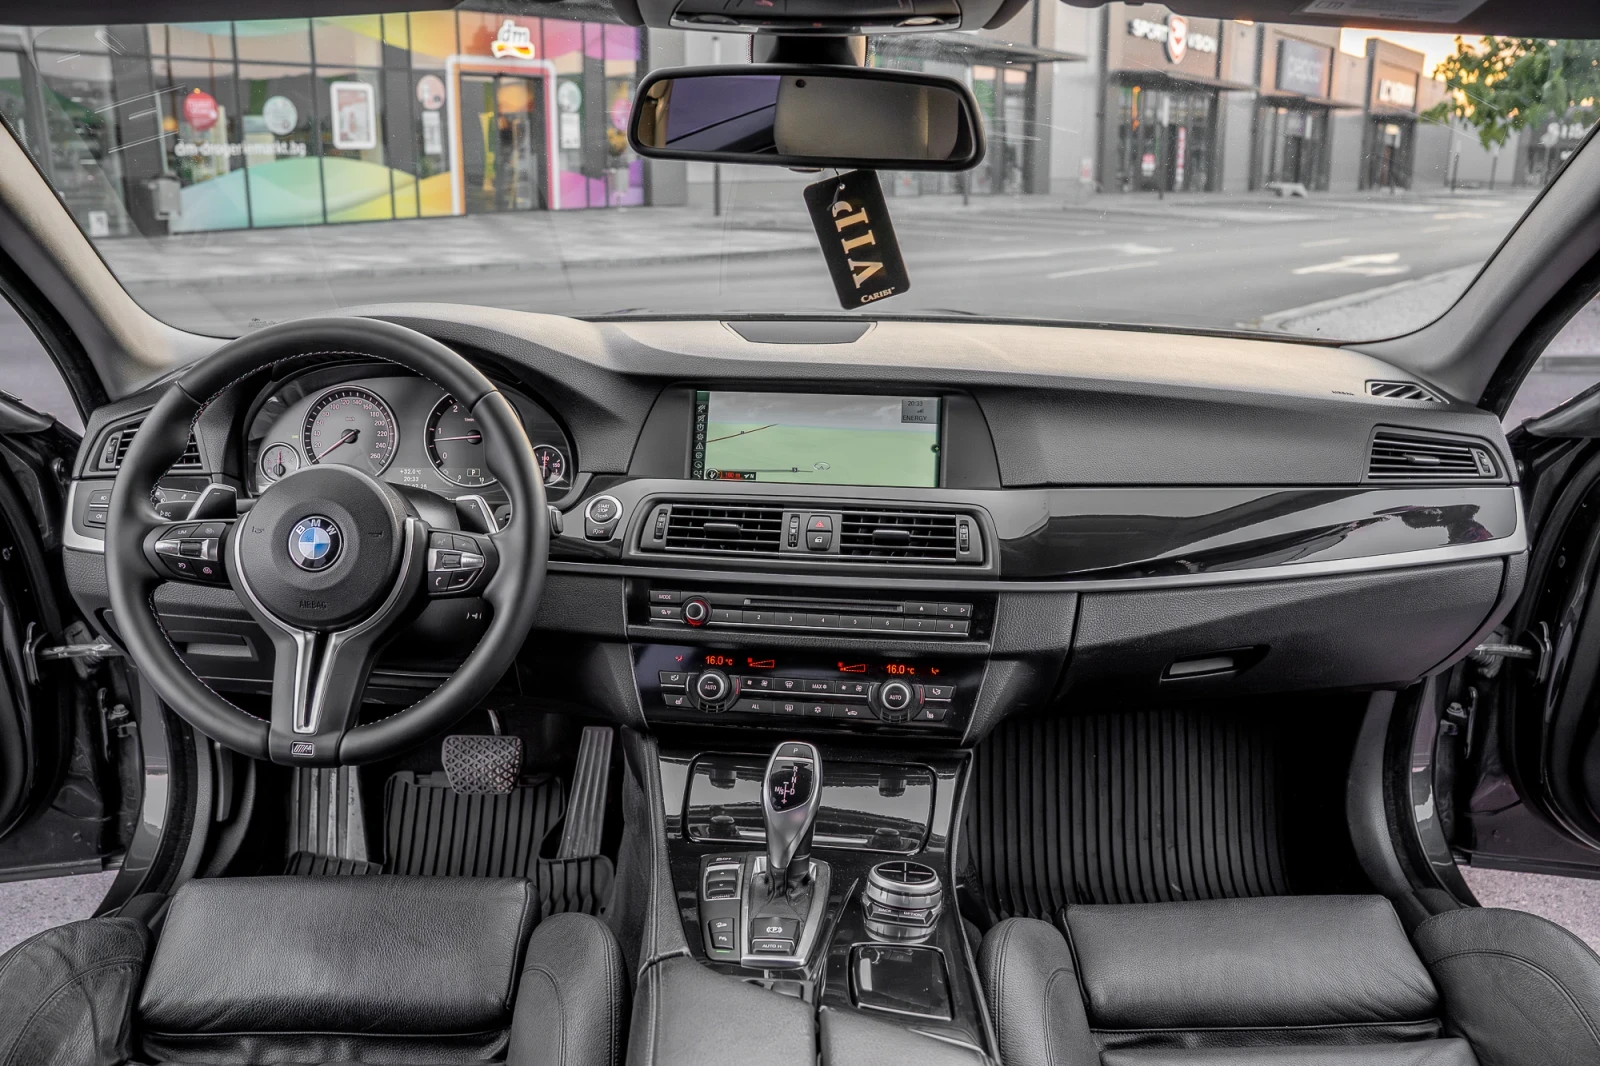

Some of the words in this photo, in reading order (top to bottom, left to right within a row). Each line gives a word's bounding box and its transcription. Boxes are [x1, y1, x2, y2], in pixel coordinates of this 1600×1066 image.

[1132, 18, 1168, 42] SPORT
[831, 200, 884, 289] VIP
[295, 518, 337, 536] BMW
[299, 600, 327, 609] AIRBAG
[704, 655, 723, 666] 16.0
[886, 664, 905, 674] 16.0
